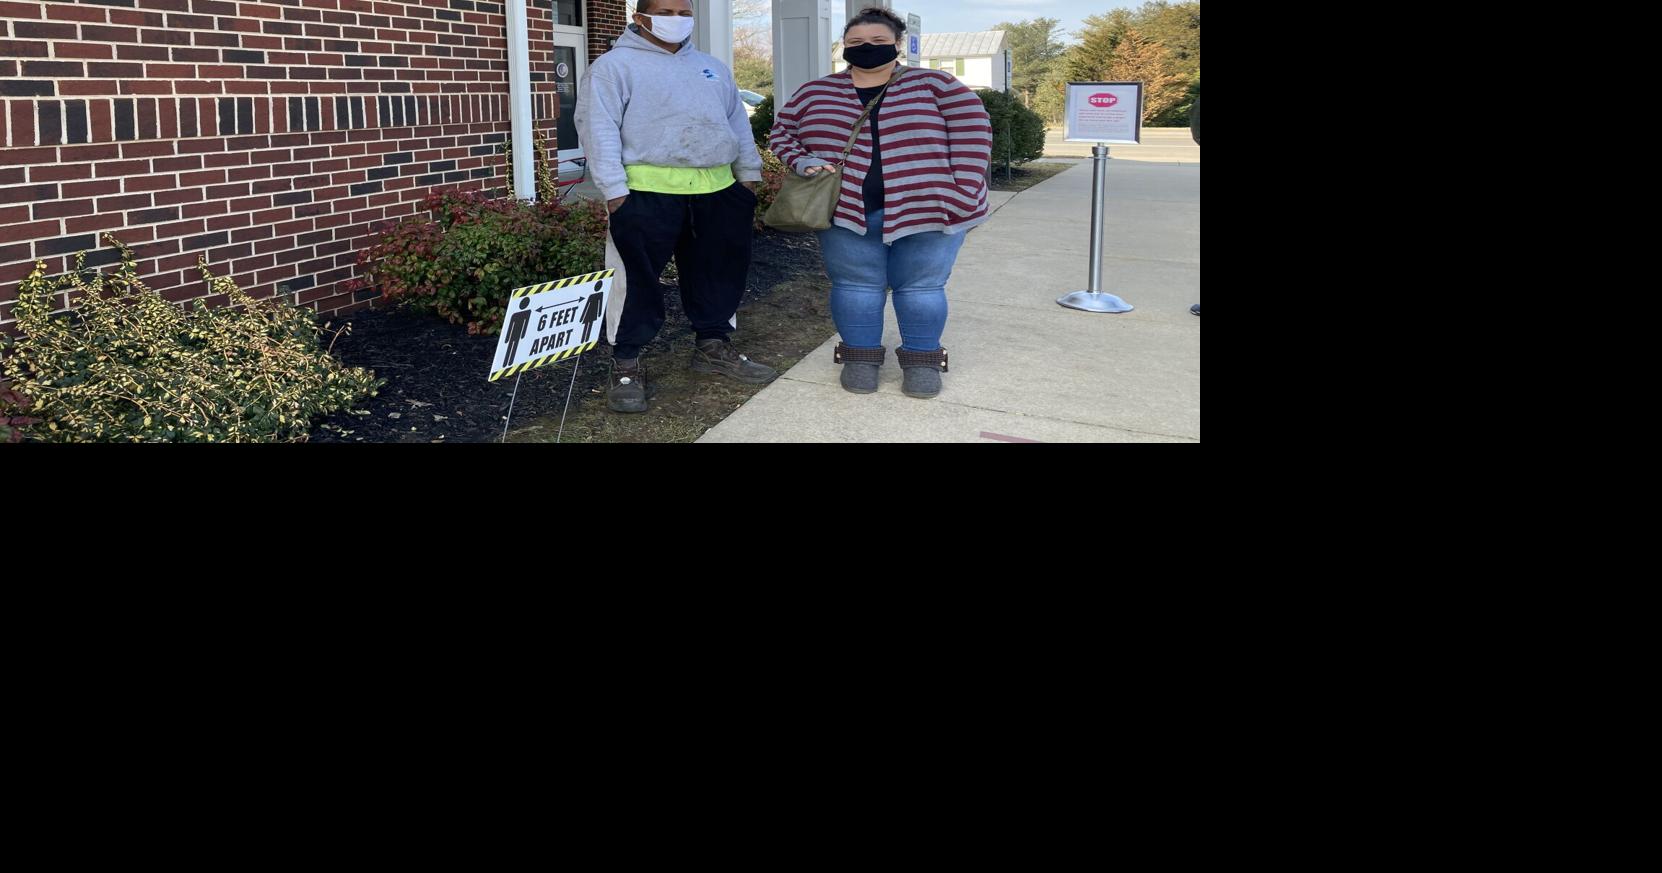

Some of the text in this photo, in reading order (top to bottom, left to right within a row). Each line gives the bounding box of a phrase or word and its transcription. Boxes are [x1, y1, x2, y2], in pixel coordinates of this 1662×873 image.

[537, 306, 579, 332] 6 FEET
[529, 329, 574, 356] APART
